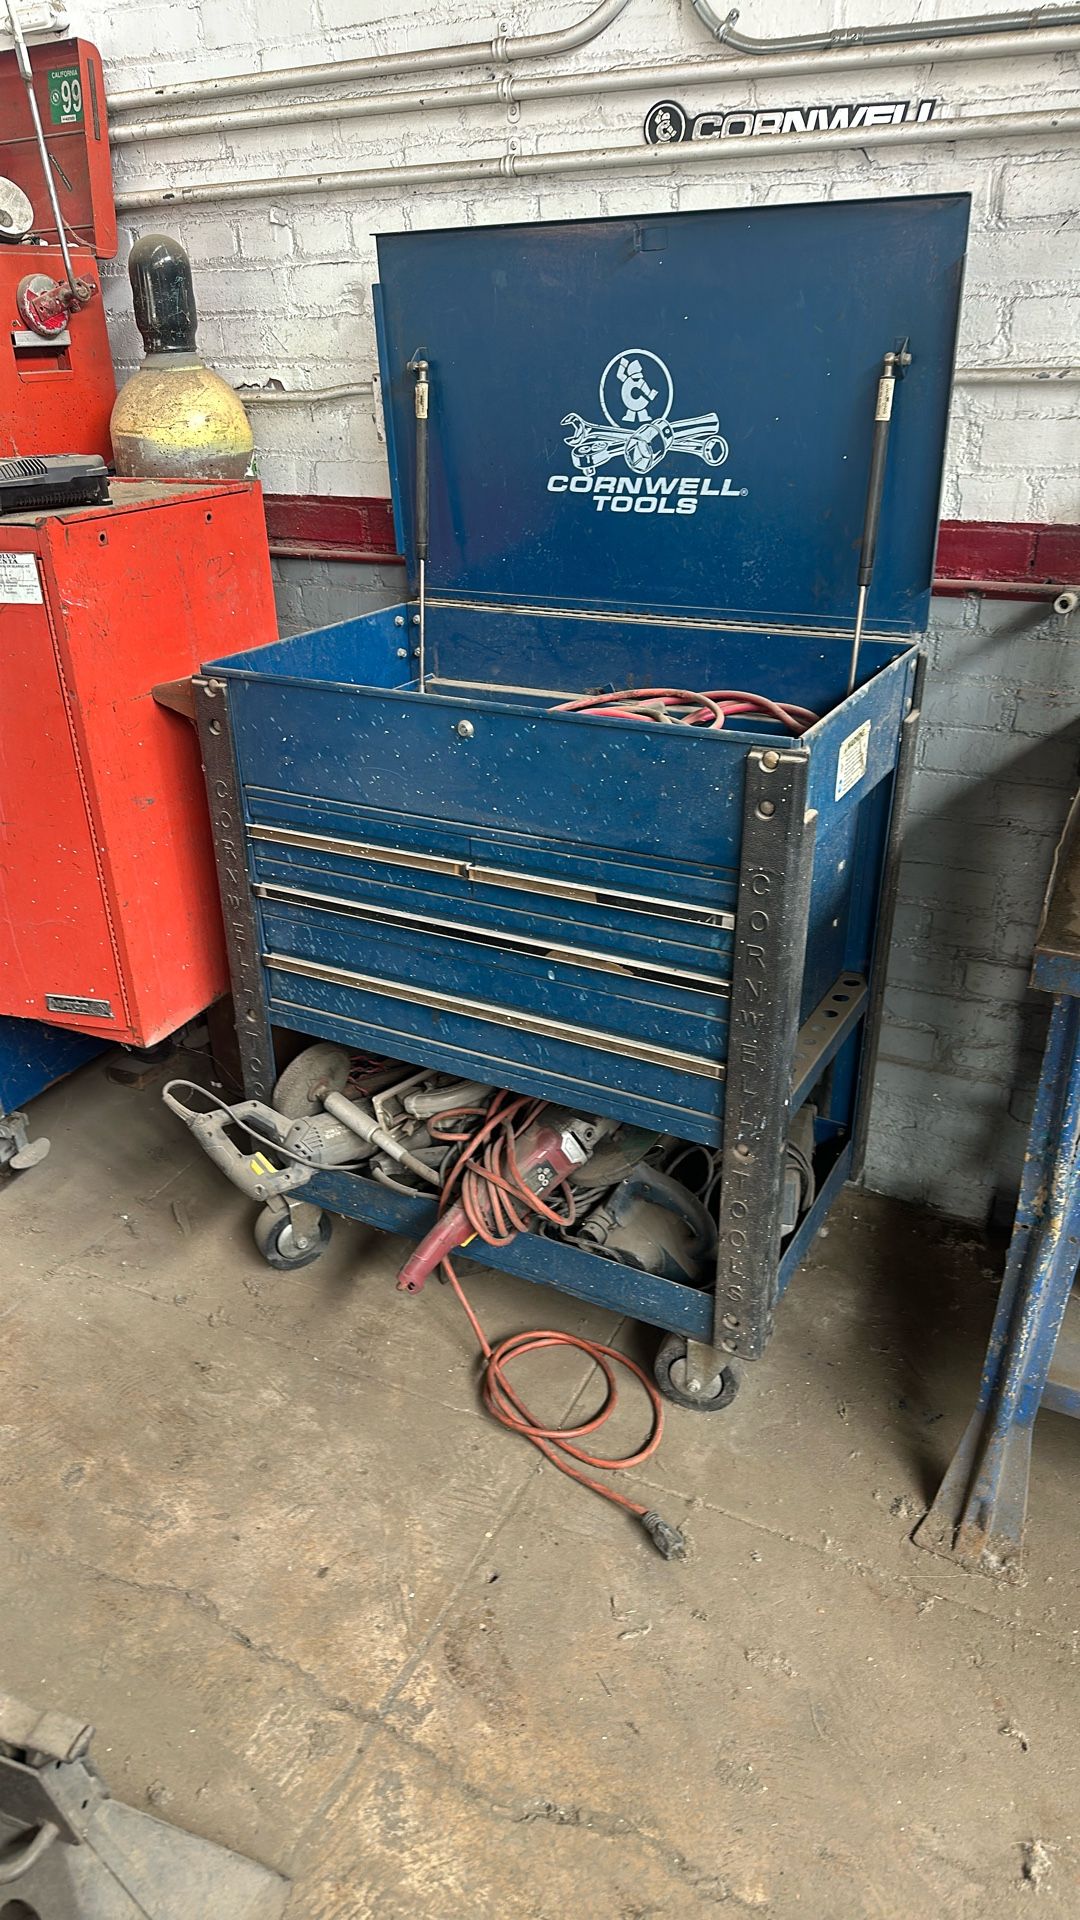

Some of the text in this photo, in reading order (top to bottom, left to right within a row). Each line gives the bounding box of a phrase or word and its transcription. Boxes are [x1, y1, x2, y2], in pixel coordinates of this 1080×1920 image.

[51, 69, 78, 79] CALIFORNIA
[61, 79, 82, 114] 99
[593, 496, 698, 515] TOOLS
[215, 779, 254, 994] CORNWELL
[727, 872, 771, 1301] CORNWELL TOOLS
